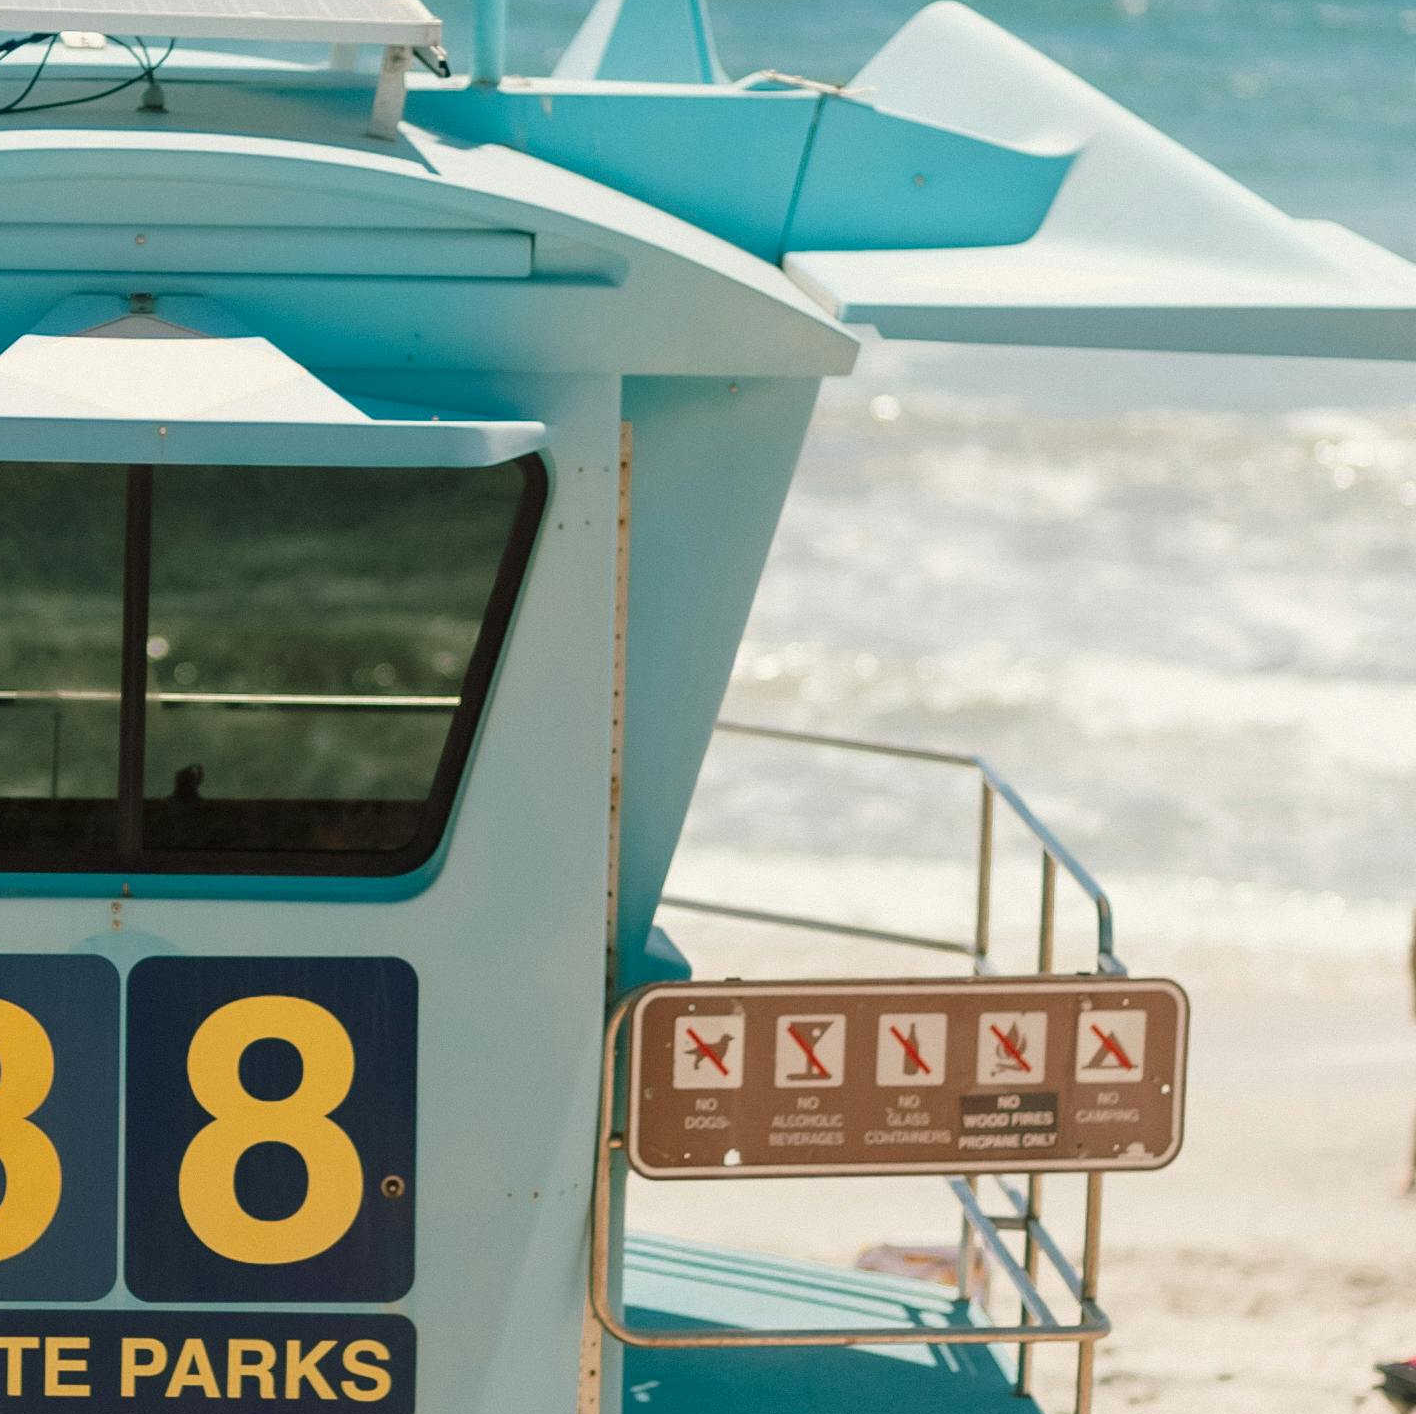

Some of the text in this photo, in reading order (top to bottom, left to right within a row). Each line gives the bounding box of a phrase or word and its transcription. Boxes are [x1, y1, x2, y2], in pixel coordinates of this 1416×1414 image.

[695, 1097, 719, 1111] NO
[797, 1096, 820, 1110] NO
[898, 1094, 921, 1108] NO
[997, 1094, 1021, 1110] NO
[1096, 1091, 1120, 1105] NO
[684, 1115, 730, 1130] DOGS
[771, 1114, 844, 1128] ALCOHOLIC
[886, 1112, 931, 1127] GLASS
[963, 1110, 1055, 1128] WOOD FIRES
[1075, 1108, 1141, 1123] CAMPING
[768, 1131, 845, 1147] BEVERAGES
[958, 1132, 1058, 1149] PROPANE ONLY
[119, 1337, 393, 1402] PARKS
